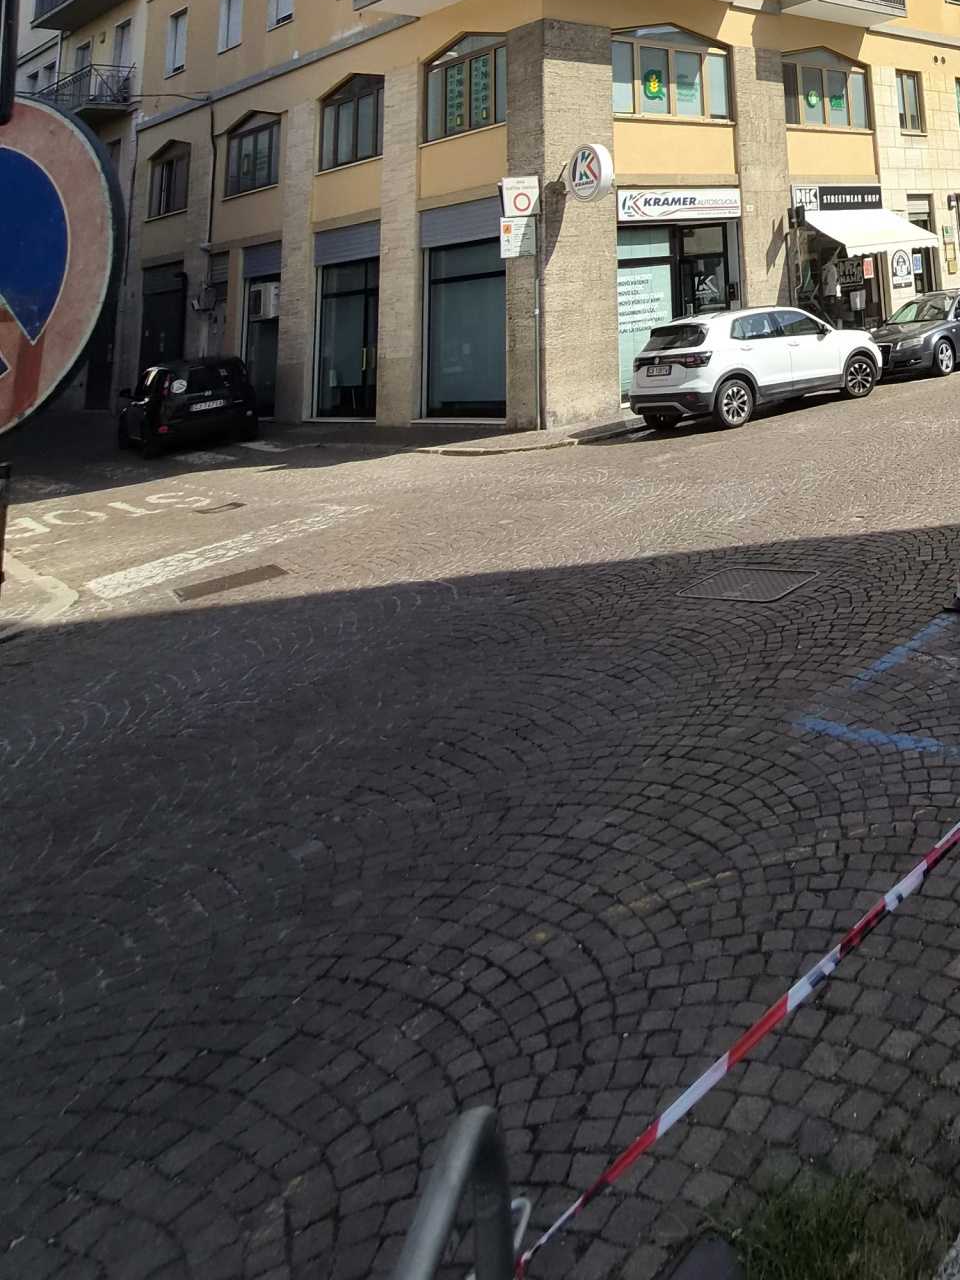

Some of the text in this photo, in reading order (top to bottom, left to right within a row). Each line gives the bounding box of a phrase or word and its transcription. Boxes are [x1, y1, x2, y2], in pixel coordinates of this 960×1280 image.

[643, 197, 697, 207] KRAMER
[822, 194, 880, 203] STREETWEAR SHOP
